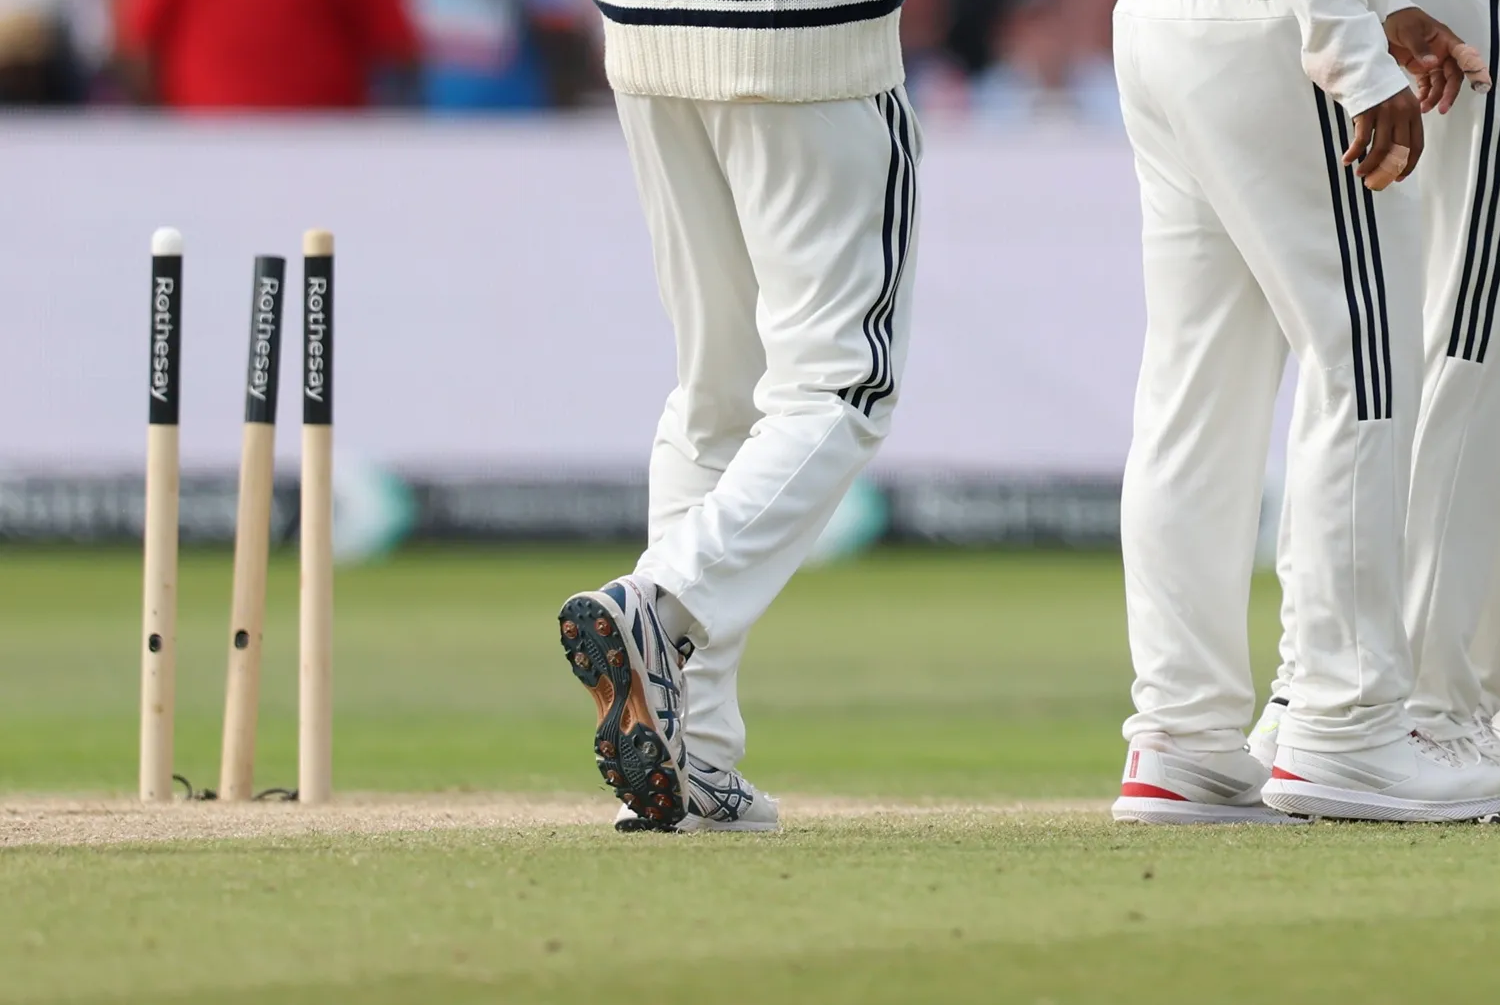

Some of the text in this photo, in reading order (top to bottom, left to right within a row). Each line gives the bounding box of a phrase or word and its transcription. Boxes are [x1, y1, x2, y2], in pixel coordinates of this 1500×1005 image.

[150, 276, 174, 403] Rothesay
[249, 276, 280, 403] Rothesay
[305, 276, 328, 403] Rothesay
